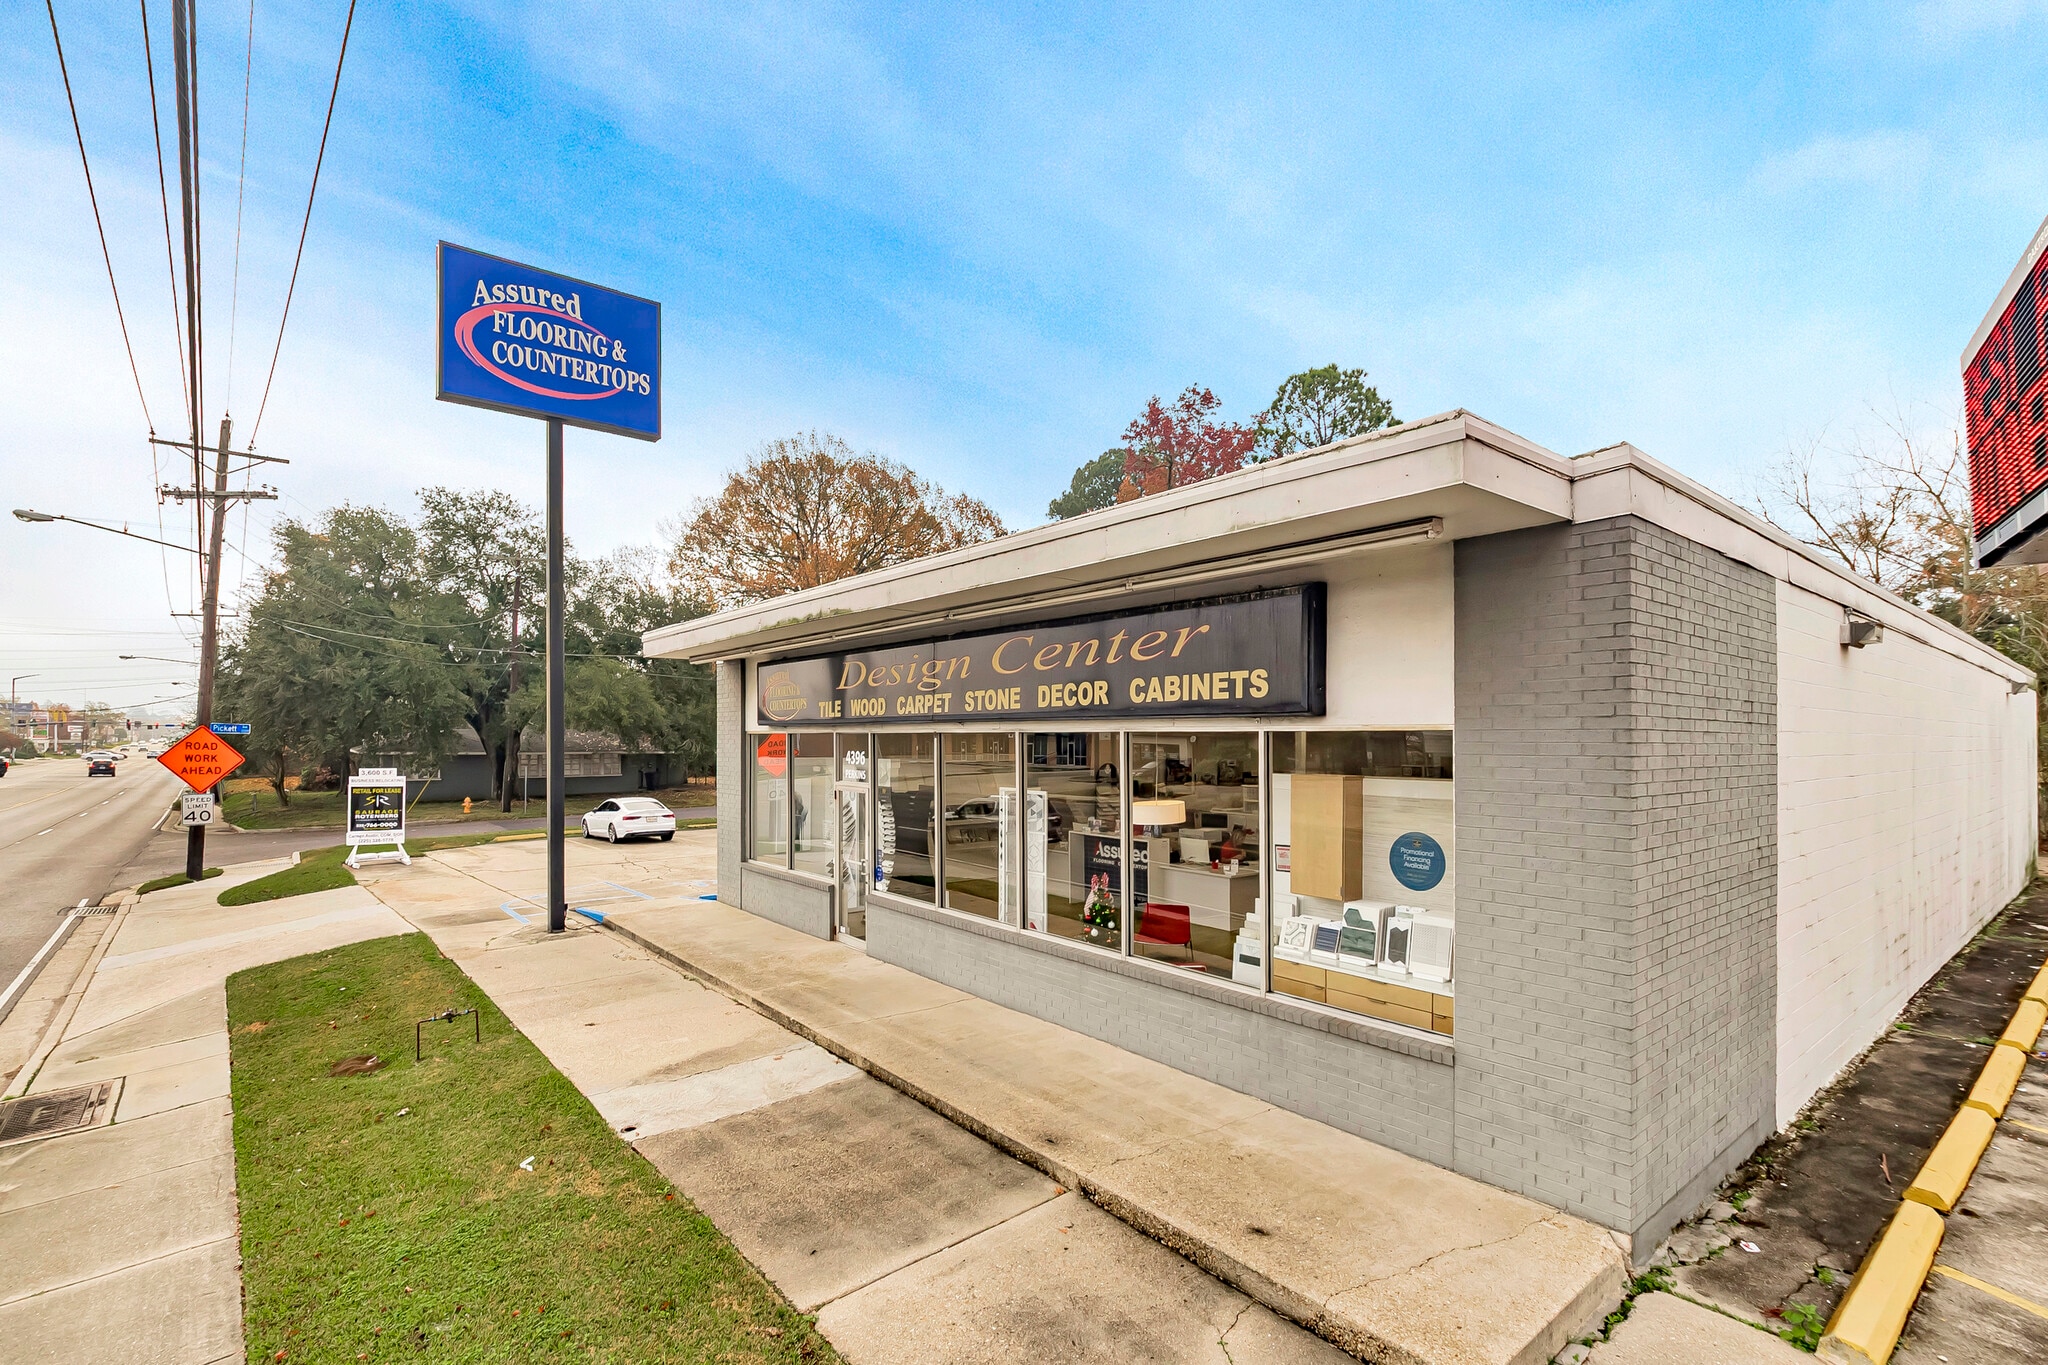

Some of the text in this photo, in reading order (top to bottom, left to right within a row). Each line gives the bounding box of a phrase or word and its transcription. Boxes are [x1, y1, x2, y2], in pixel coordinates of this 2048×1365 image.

[471, 279, 583, 321] Assured
[493, 309, 627, 363] FLOORING &
[492, 340, 651, 396] COUNTERTOPS
[836, 624, 1210, 691] Design Center
[818, 668, 1269, 718] TILE WOOD CARPET STONE DECOR CABINETS
[185, 741, 218, 750] ROAD
[184, 754, 218, 762] WORK
[845, 750, 866, 765] 4396
[181, 766, 222, 775] AHEAD
[845, 769, 866, 780] PERKINS
[183, 810, 211, 822] 40
[1400, 846, 1435, 858] Promotional
[1403, 854, 1431, 867] Financing
[1403, 861, 1430, 870] Available
